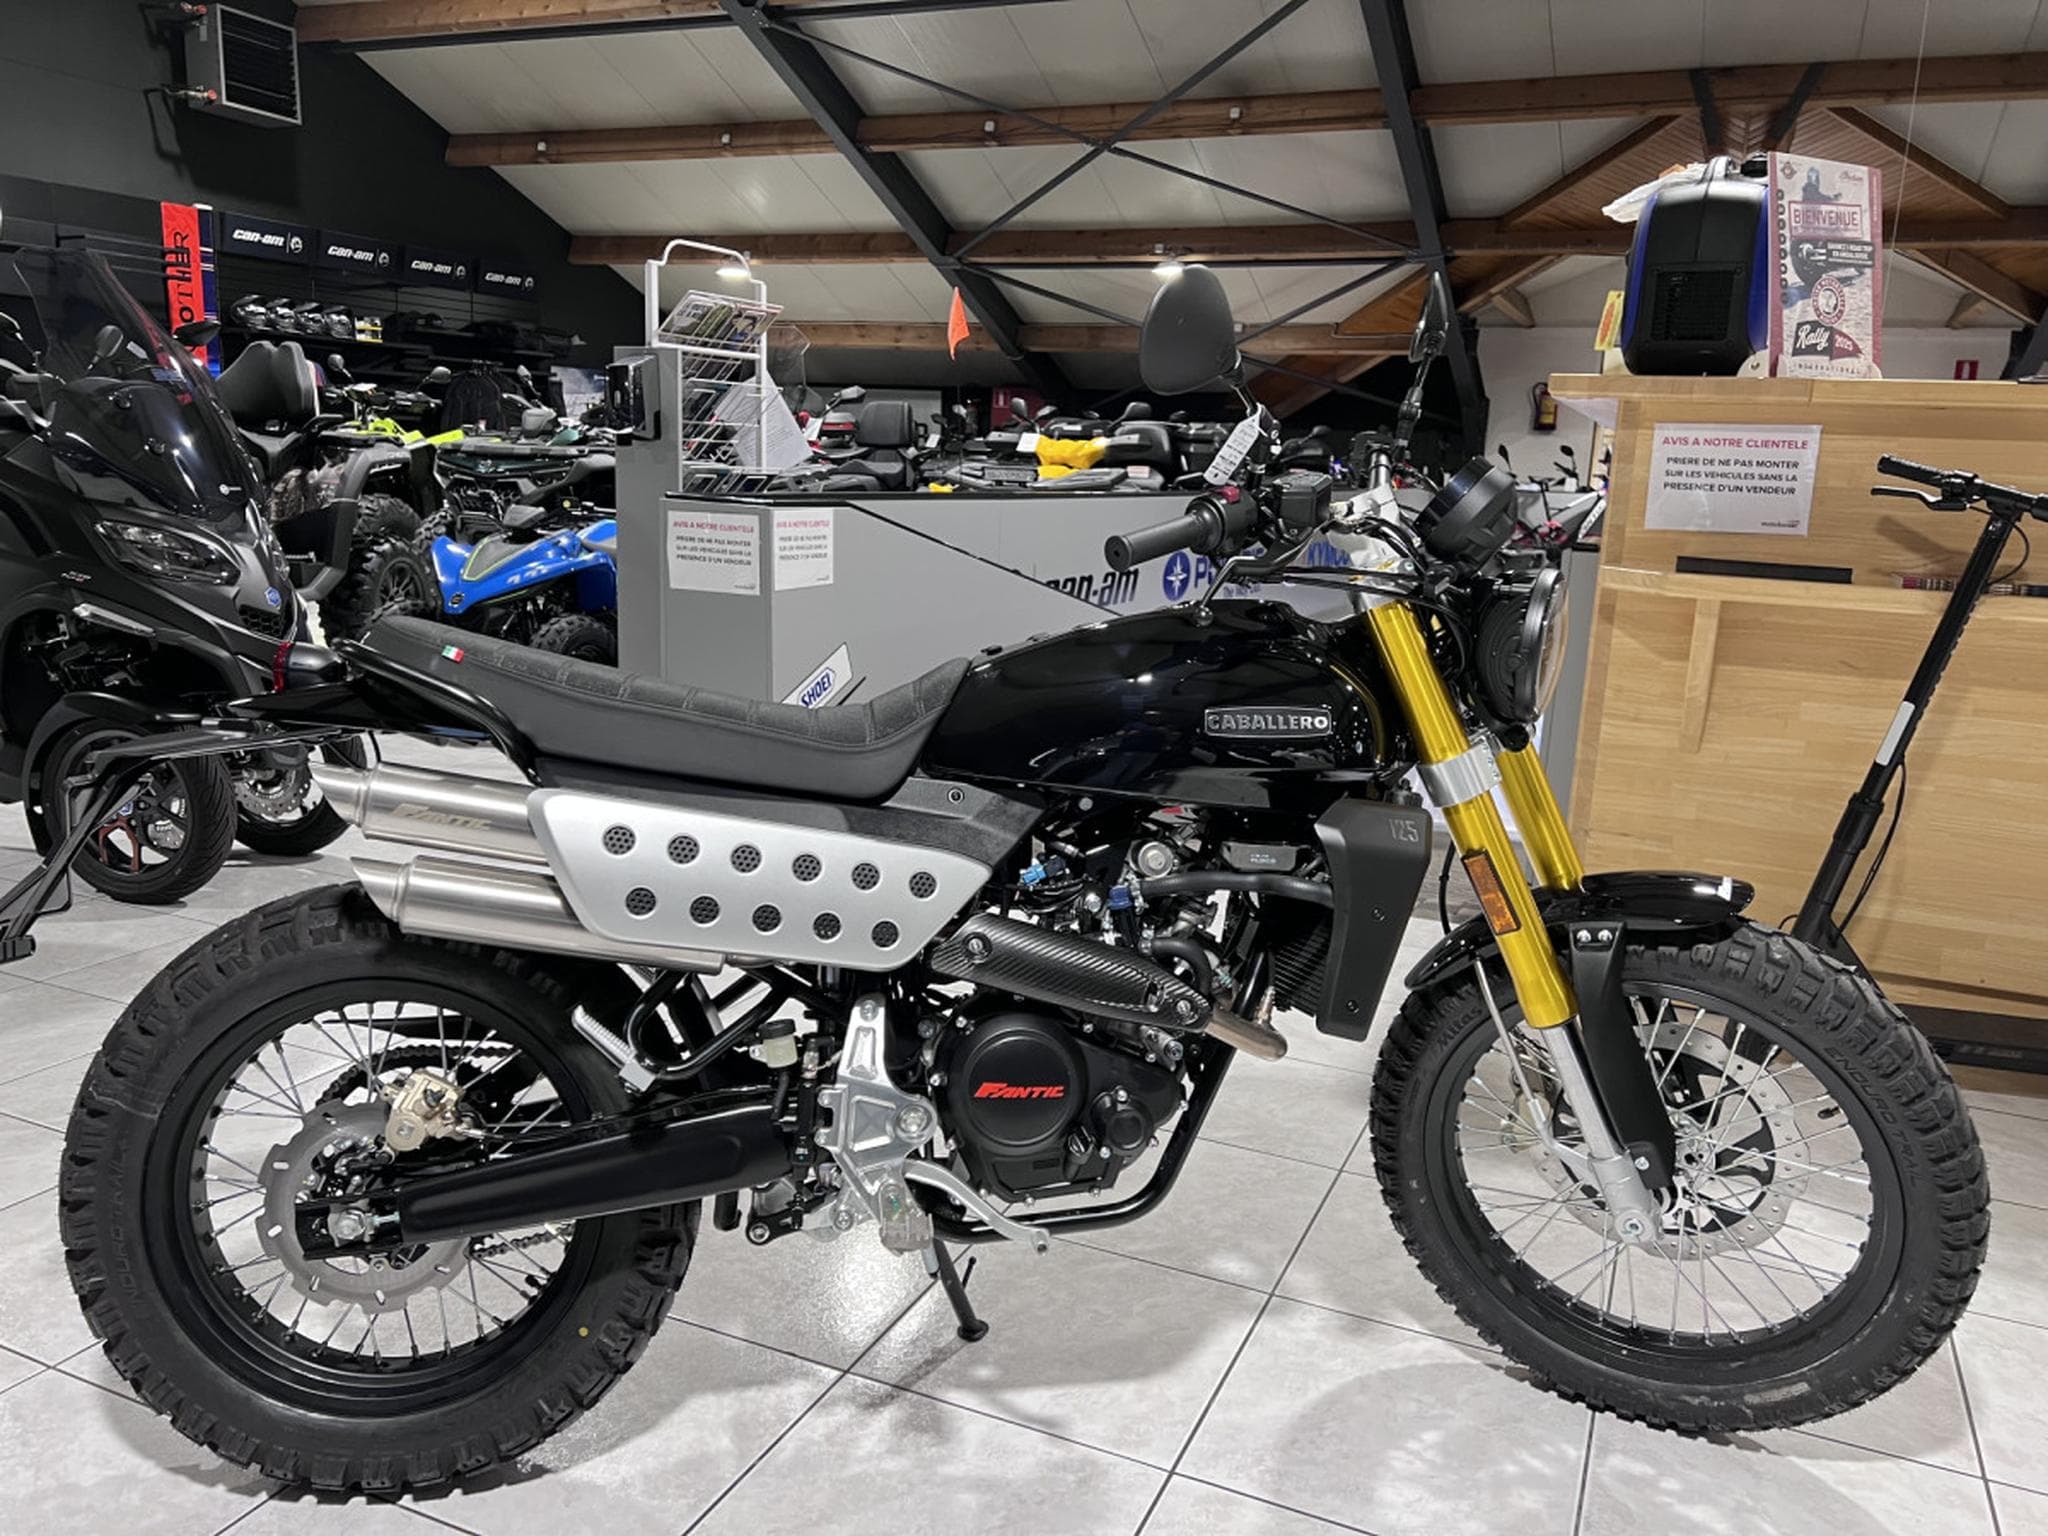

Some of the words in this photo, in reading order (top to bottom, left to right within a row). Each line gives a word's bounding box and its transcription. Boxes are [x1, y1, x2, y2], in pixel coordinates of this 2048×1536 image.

[1793, 208, 1859, 226] BIENVENUE
[232, 228, 285, 247] can-am
[327, 244, 374, 262] can-am
[411, 259, 452, 275] can-am
[485, 271, 522, 286] can-am
[1796, 324, 1831, 350] Rally
[1662, 436, 1689, 446] AVIS
[1691, 437, 1701, 446] A
[1703, 437, 1742, 448] NOTRE
[1745, 439, 1809, 450] CLIENTELE
[1666, 456, 1700, 466] PRIERE
[1702, 457, 1715, 467] DE
[1718, 458, 1731, 467] NE
[1734, 459, 1753, 468] PAS
[1755, 459, 1800, 469] MONTER
[1685, 470, 1702, 478] LES
[1704, 471, 1756, 480] VEHICULES
[1758, 472, 1783, 481] SANS
[1785, 474, 1798, 482] LA
[1663, 483, 1715, 492] PRESENCE
[1717, 484, 1743, 493] D'UN
[1745, 485, 1797, 495] VENDEUR
[801, 672, 832, 707] SHOEI
[1206, 713, 1330, 731] CABALLERO
[389, 802, 493, 831] FANTIC
[973, 1081, 1066, 1099] FANTIC
[1823, 1047, 1899, 1127] ENDURO
[1889, 1129, 1926, 1190] TRAIL
